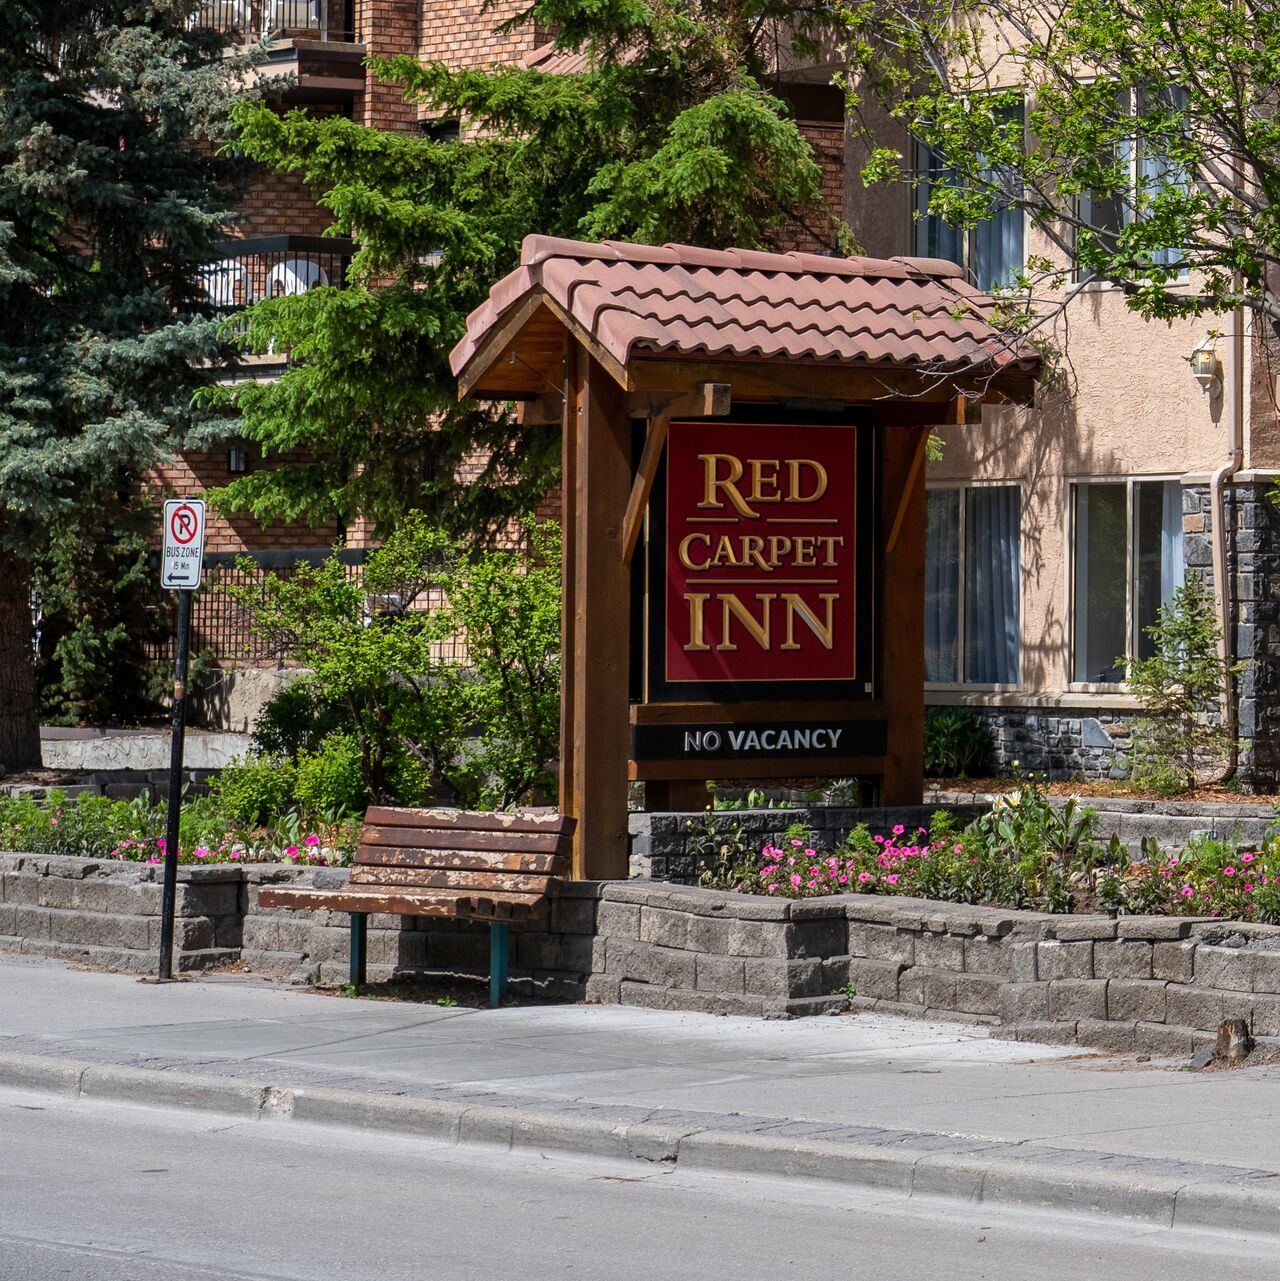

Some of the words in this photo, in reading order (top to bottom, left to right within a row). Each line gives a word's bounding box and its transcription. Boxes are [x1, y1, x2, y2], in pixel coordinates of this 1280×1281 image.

[697, 453, 828, 518] RED
[166, 546, 180, 558] BUS
[180, 547, 199, 558] ZONE
[678, 533, 844, 571] CARPET
[683, 593, 839, 650] INN
[684, 731, 722, 751] NO
[728, 729, 842, 750] VACANCY
